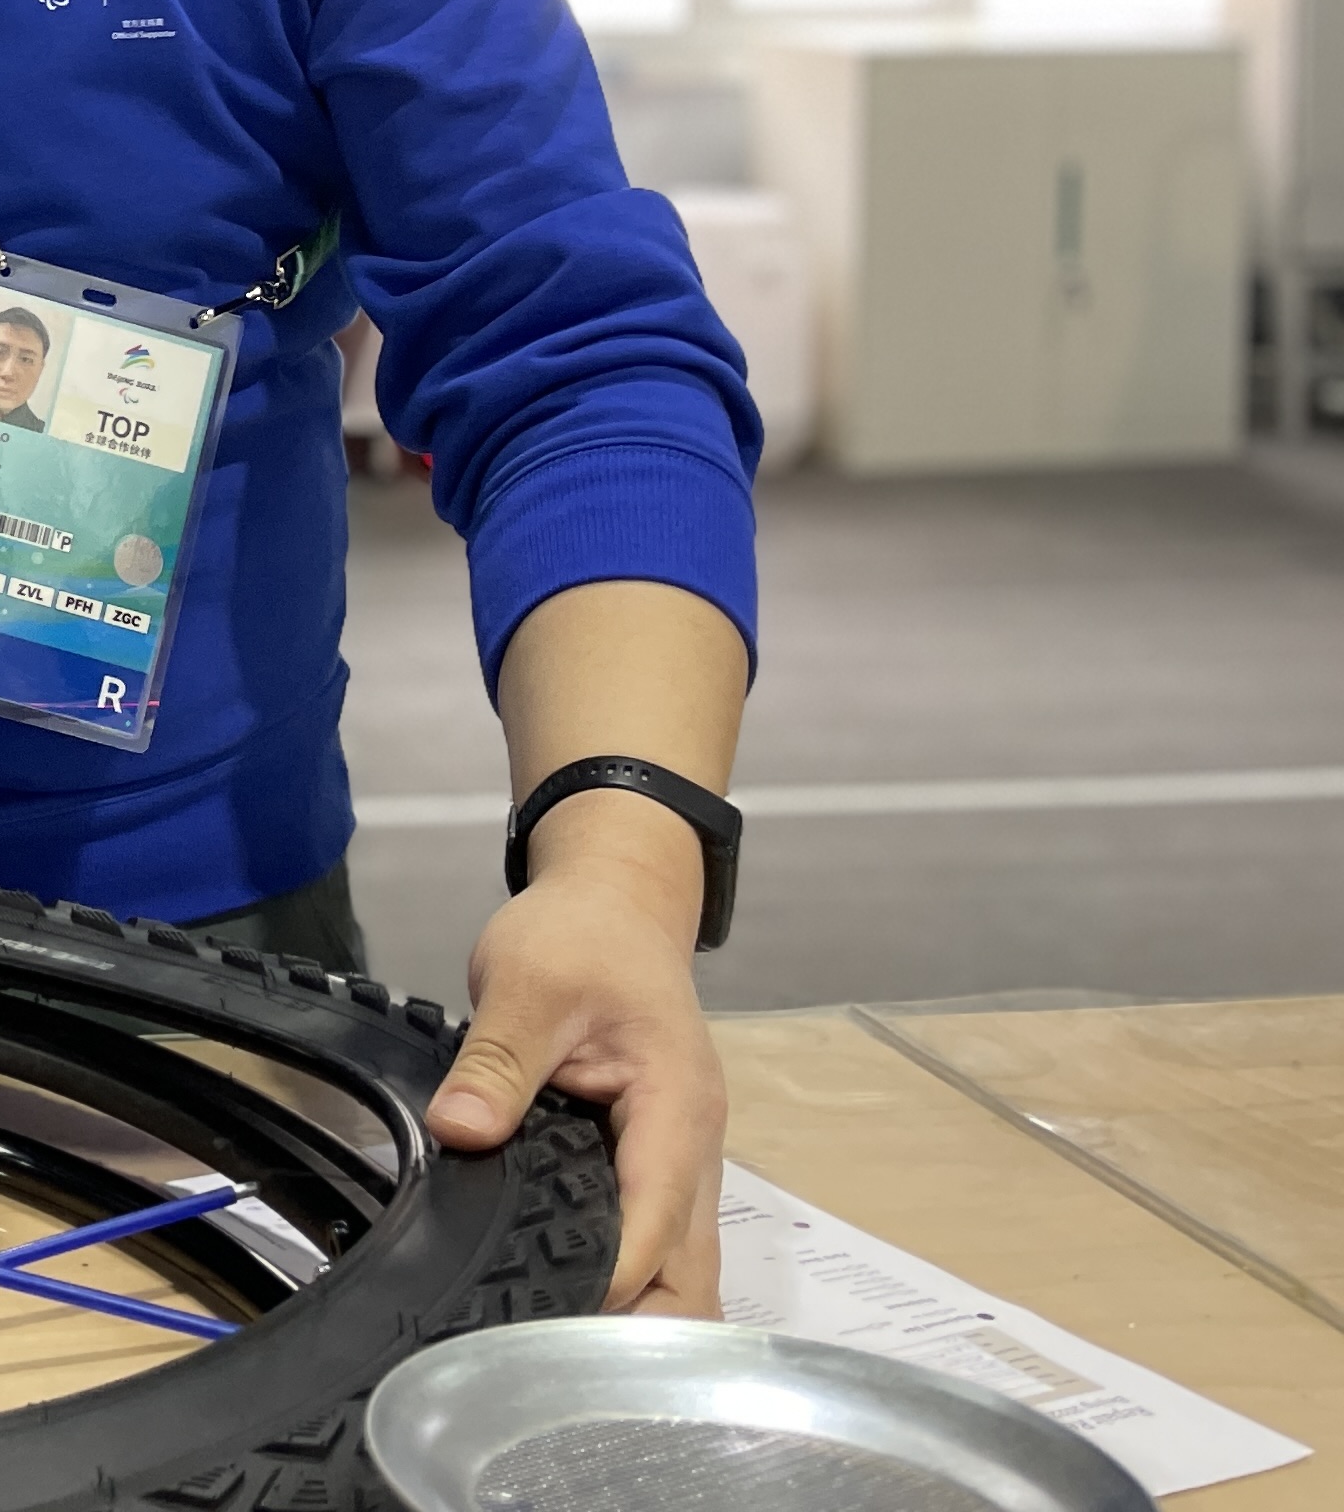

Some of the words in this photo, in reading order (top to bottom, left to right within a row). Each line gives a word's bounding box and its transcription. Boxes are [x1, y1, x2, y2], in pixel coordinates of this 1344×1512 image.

[97, 409, 150, 442] TOP
[17, 583, 43, 601] ZVL
[65, 597, 93, 614] PFH
[112, 610, 141, 627] ZGC
[97, 675, 126, 713] R
